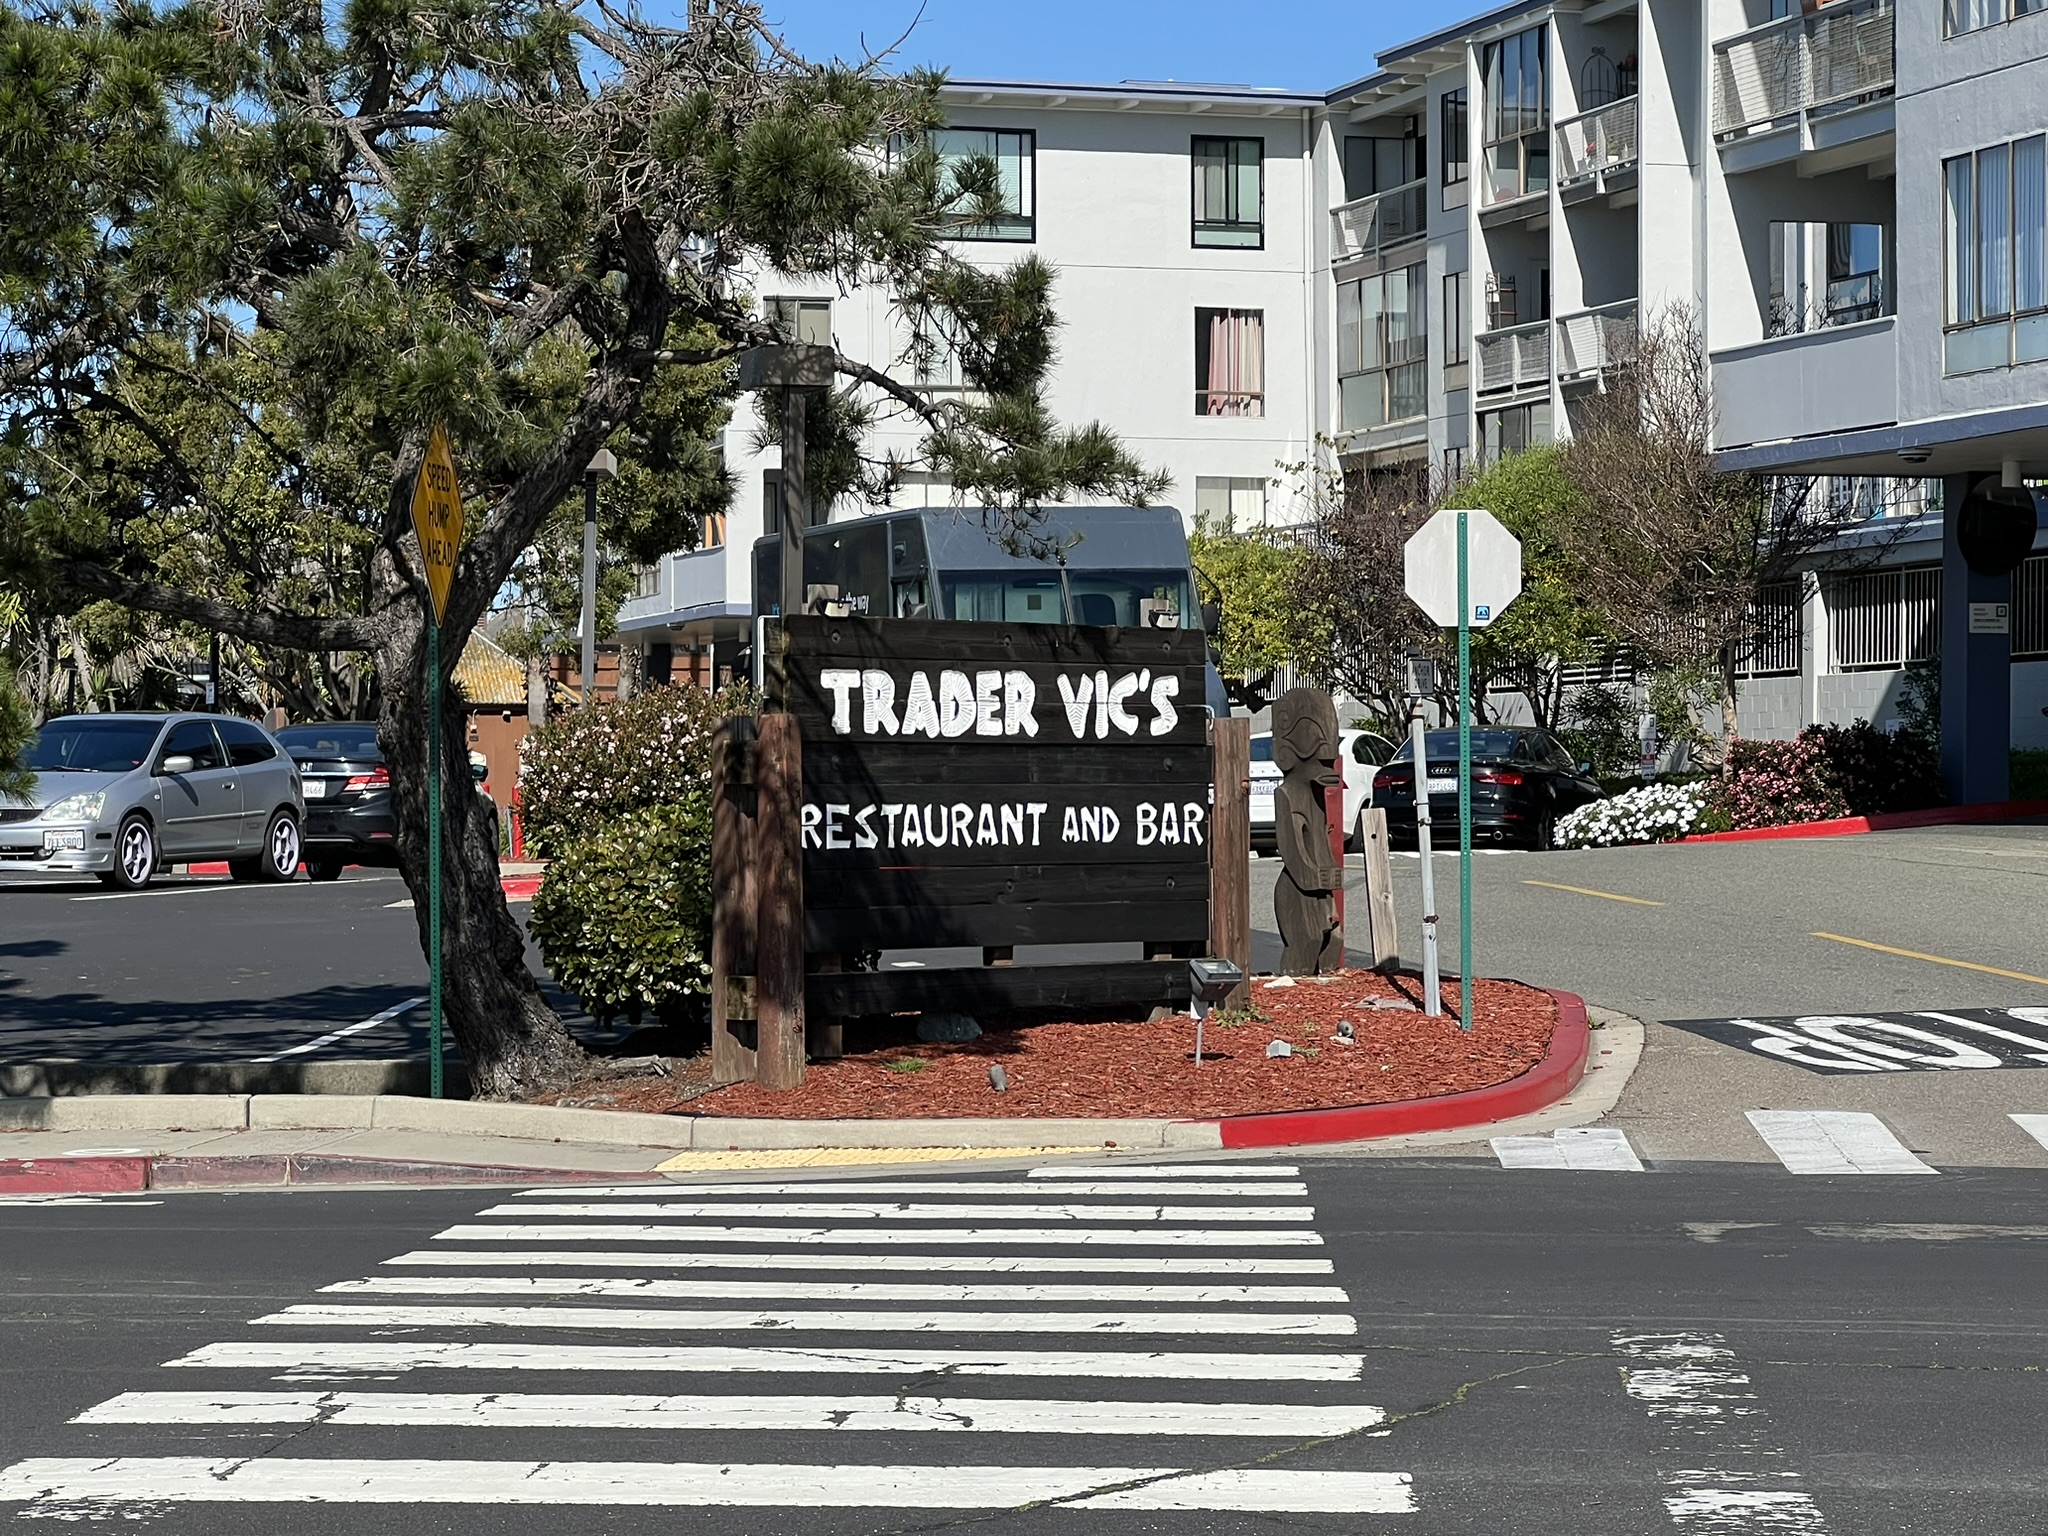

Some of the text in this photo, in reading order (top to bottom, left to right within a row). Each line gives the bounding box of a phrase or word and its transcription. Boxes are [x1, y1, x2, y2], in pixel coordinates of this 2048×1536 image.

[427, 462, 451, 492] SPEED
[428, 500, 450, 529] HUMP
[427, 538, 452, 567] AHEAD
[857, 595, 869, 614] way
[820, 668, 1179, 739] TRADER VIC'S
[801, 802, 1204, 850] RESTAURANT AND BAR
